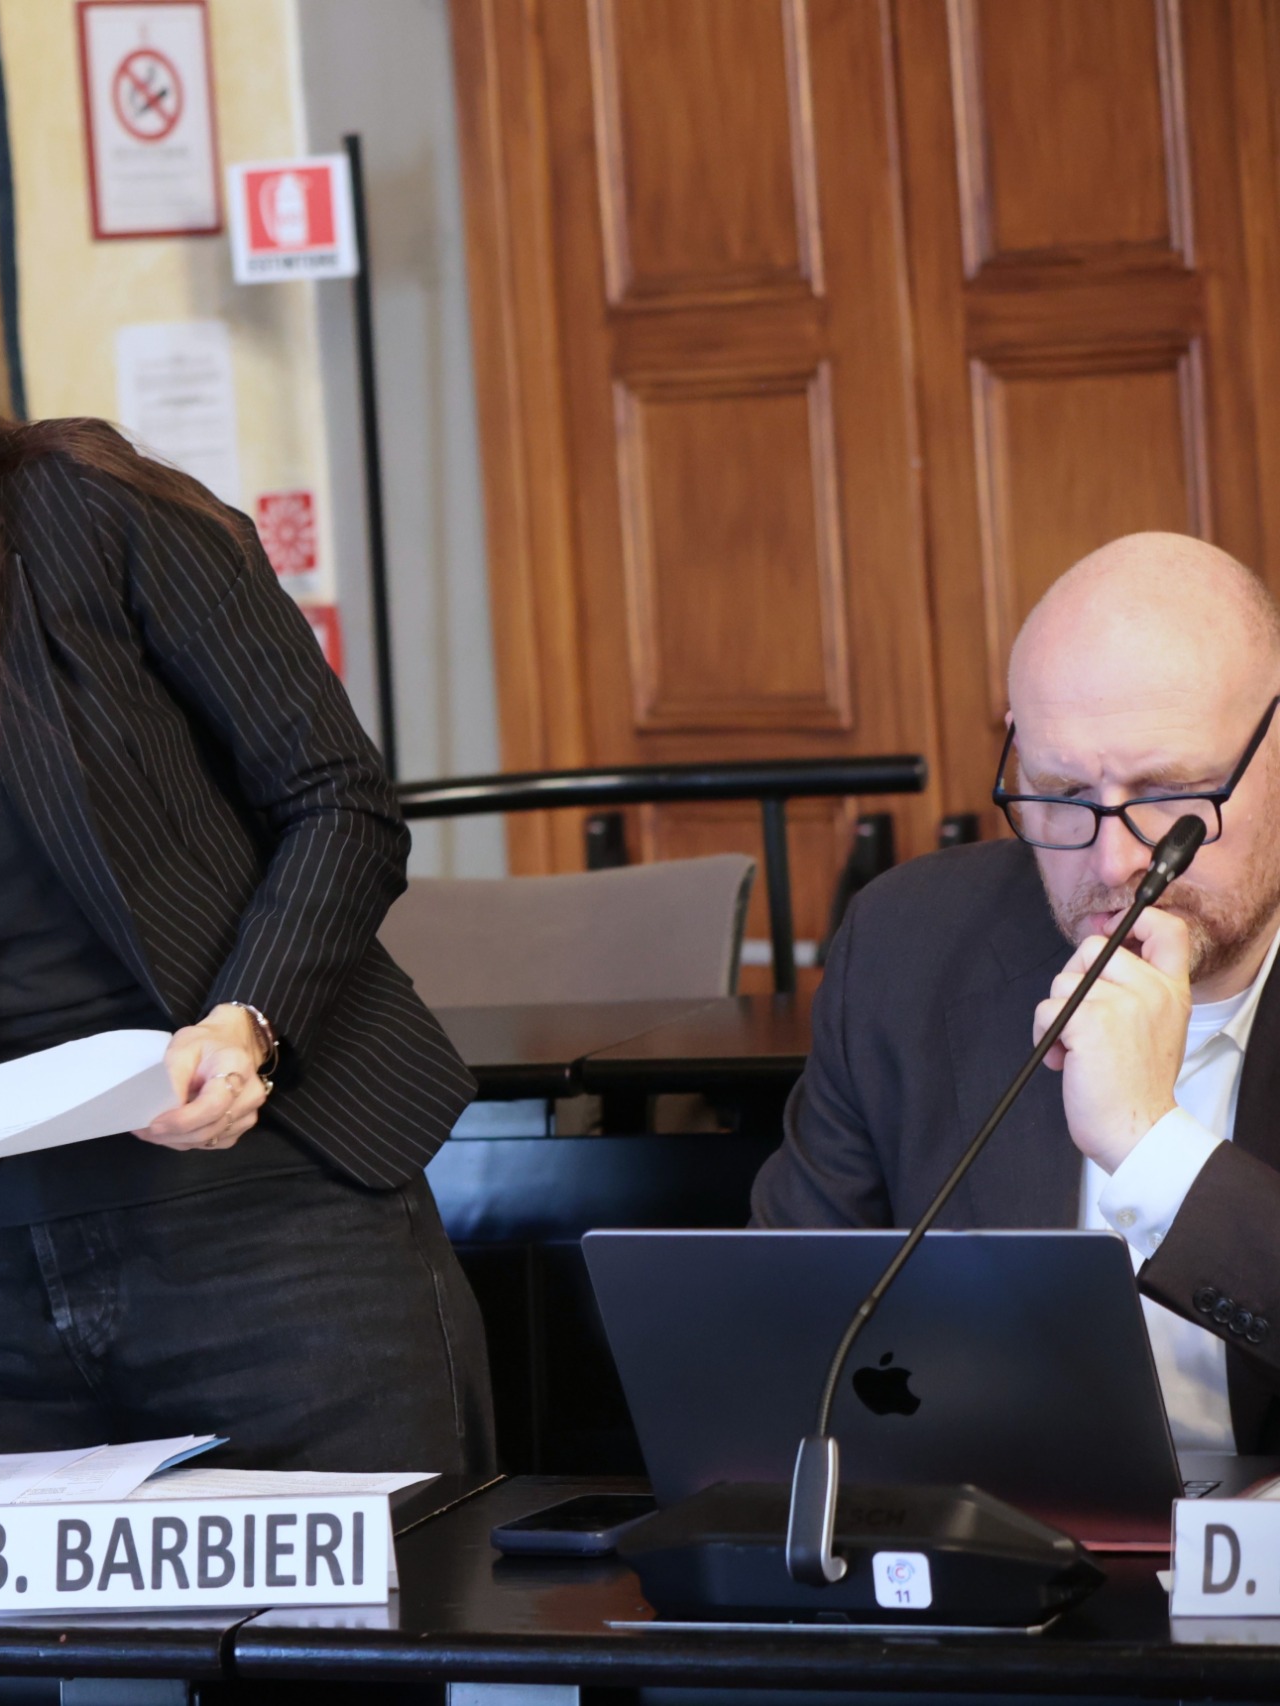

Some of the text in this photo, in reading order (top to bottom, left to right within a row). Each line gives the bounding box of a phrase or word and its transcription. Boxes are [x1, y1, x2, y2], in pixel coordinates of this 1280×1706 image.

[56, 1511, 365, 1592] BARBIERI
[1202, 1523, 1257, 1596] D.
[894, 1589, 911, 1604] 11
